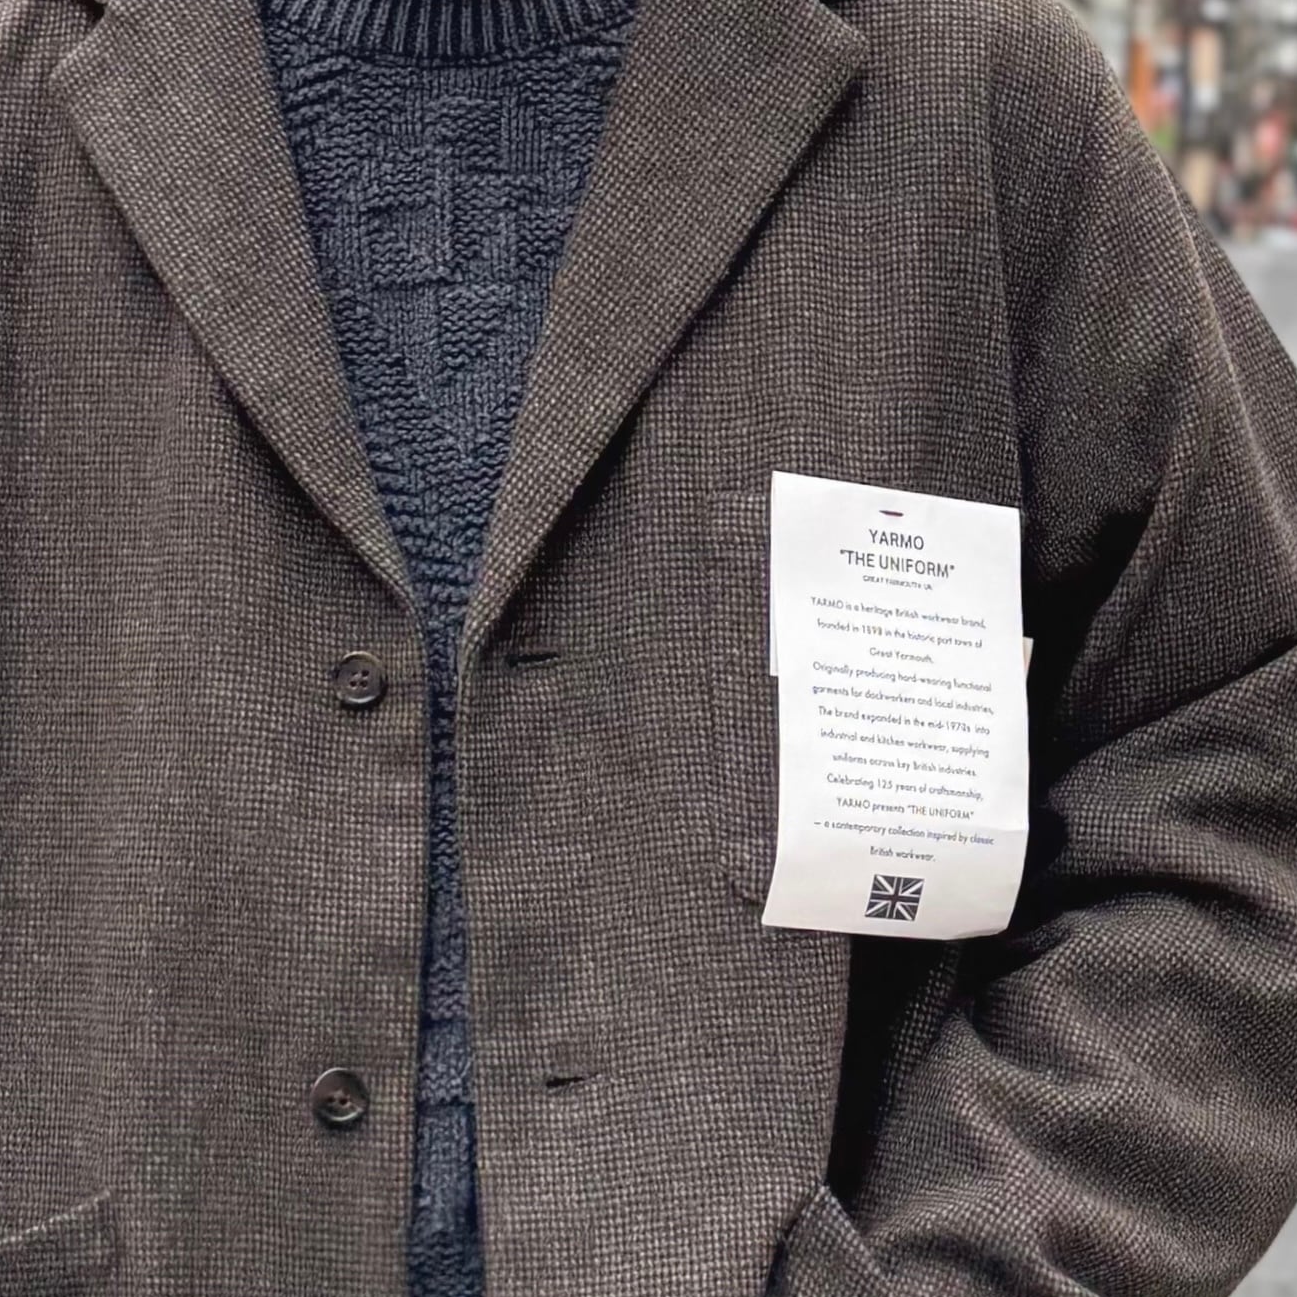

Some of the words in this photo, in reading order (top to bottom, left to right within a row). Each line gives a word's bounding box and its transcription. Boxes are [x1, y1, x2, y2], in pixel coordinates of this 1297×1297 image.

[868, 528, 925, 551] YARMO
[879, 553, 955, 579] UNIFORM"
[811, 596, 844, 609] YARMO
[846, 603, 852, 611] is
[854, 604, 859, 612] a
[861, 602, 893, 618] heritage
[895, 607, 919, 619] British
[922, 613, 959, 624] workwear
[817, 617, 850, 632] founded
[894, 629, 906, 639] the
[937, 636, 953, 646] port
[975, 639, 983, 648] of
[870, 646, 893, 658] Great
[813, 660, 854, 677] Originally
[856, 668, 896, 683] producing
[953, 677, 992, 692] functional
[812, 685, 849, 697] garments
[851, 686, 863, 698] for
[865, 689, 915, 704] dockworkers
[917, 697, 933, 707] and
[935, 698, 954, 709] local
[819, 704, 833, 716] The
[835, 707, 859, 720] brand
[861, 713, 902, 725] expanded
[913, 717, 925, 727] the
[975, 726, 990, 735] into
[821, 728, 857, 742] industrial
[860, 734, 875, 743] and
[952, 745, 989, 759] supplying
[833, 752, 867, 765] uniforms
[897, 759, 911, 772] key
[913, 760, 936, 772] British
[827, 772, 874, 790] Celebrating
[878, 778, 893, 790] 125
[896, 783, 917, 792] years
[919, 783, 927, 794] of
[837, 797, 871, 810] YARMO
[872, 802, 905, 814] presents
[824, 820, 830, 828] a
[832, 821, 887, 836] contemporary
[888, 824, 925, 838] collection
[927, 831, 957, 842] inspired
[958, 831, 968, 845] by
[970, 833, 994, 845] classic
[870, 845, 894, 857] British
